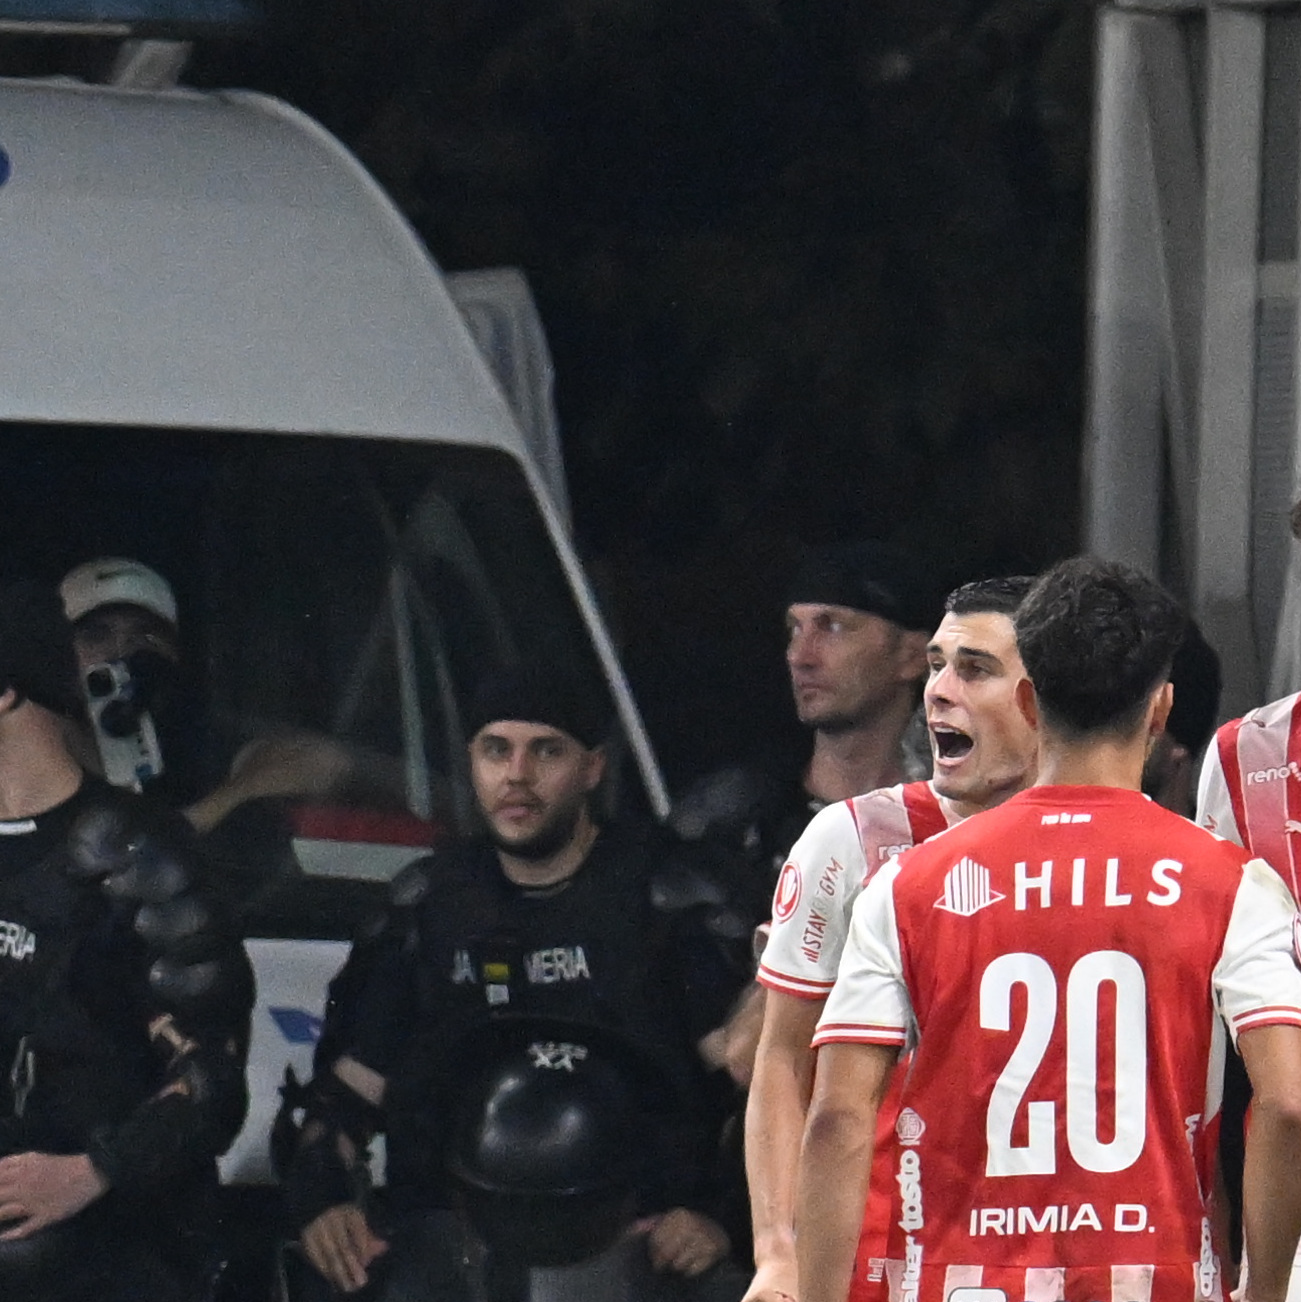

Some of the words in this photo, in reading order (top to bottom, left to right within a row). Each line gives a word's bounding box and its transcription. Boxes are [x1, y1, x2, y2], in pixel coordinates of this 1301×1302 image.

[1014, 857, 1183, 911] HILS
[979, 950, 1148, 1178] 20
[969, 1203, 1103, 1236] IRIMIA
[1114, 1202, 1155, 1234] D.
